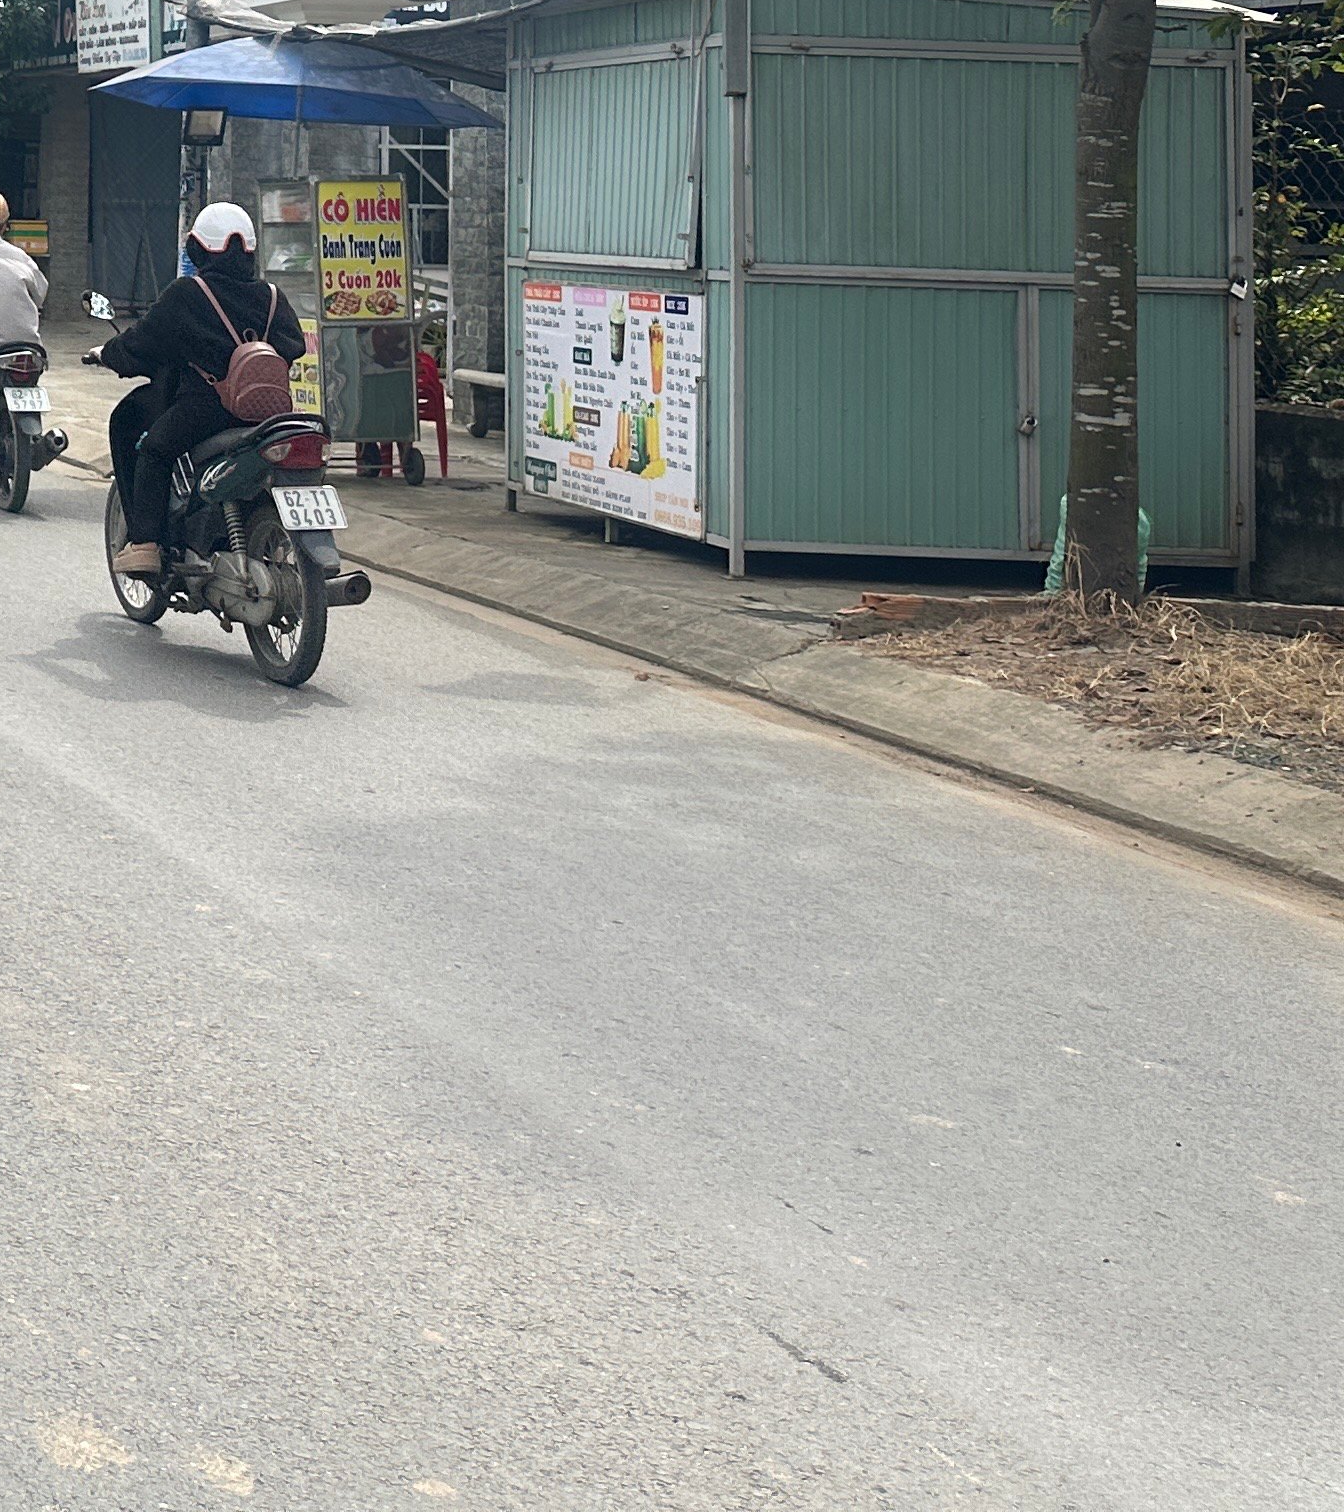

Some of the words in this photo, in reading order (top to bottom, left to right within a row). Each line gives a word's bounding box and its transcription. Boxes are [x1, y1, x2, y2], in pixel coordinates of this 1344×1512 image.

[322, 191, 350, 224] CÔ
[355, 184, 401, 224] HIỀN
[322, 234, 346, 259] Bánh
[378, 232, 402, 259] Cuốn
[325, 271, 333, 289] 3
[338, 269, 371, 289] Cuốn
[376, 269, 402, 289] 20k
[283, 490, 331, 507] 62-T1
[289, 508, 337, 527] 9403
